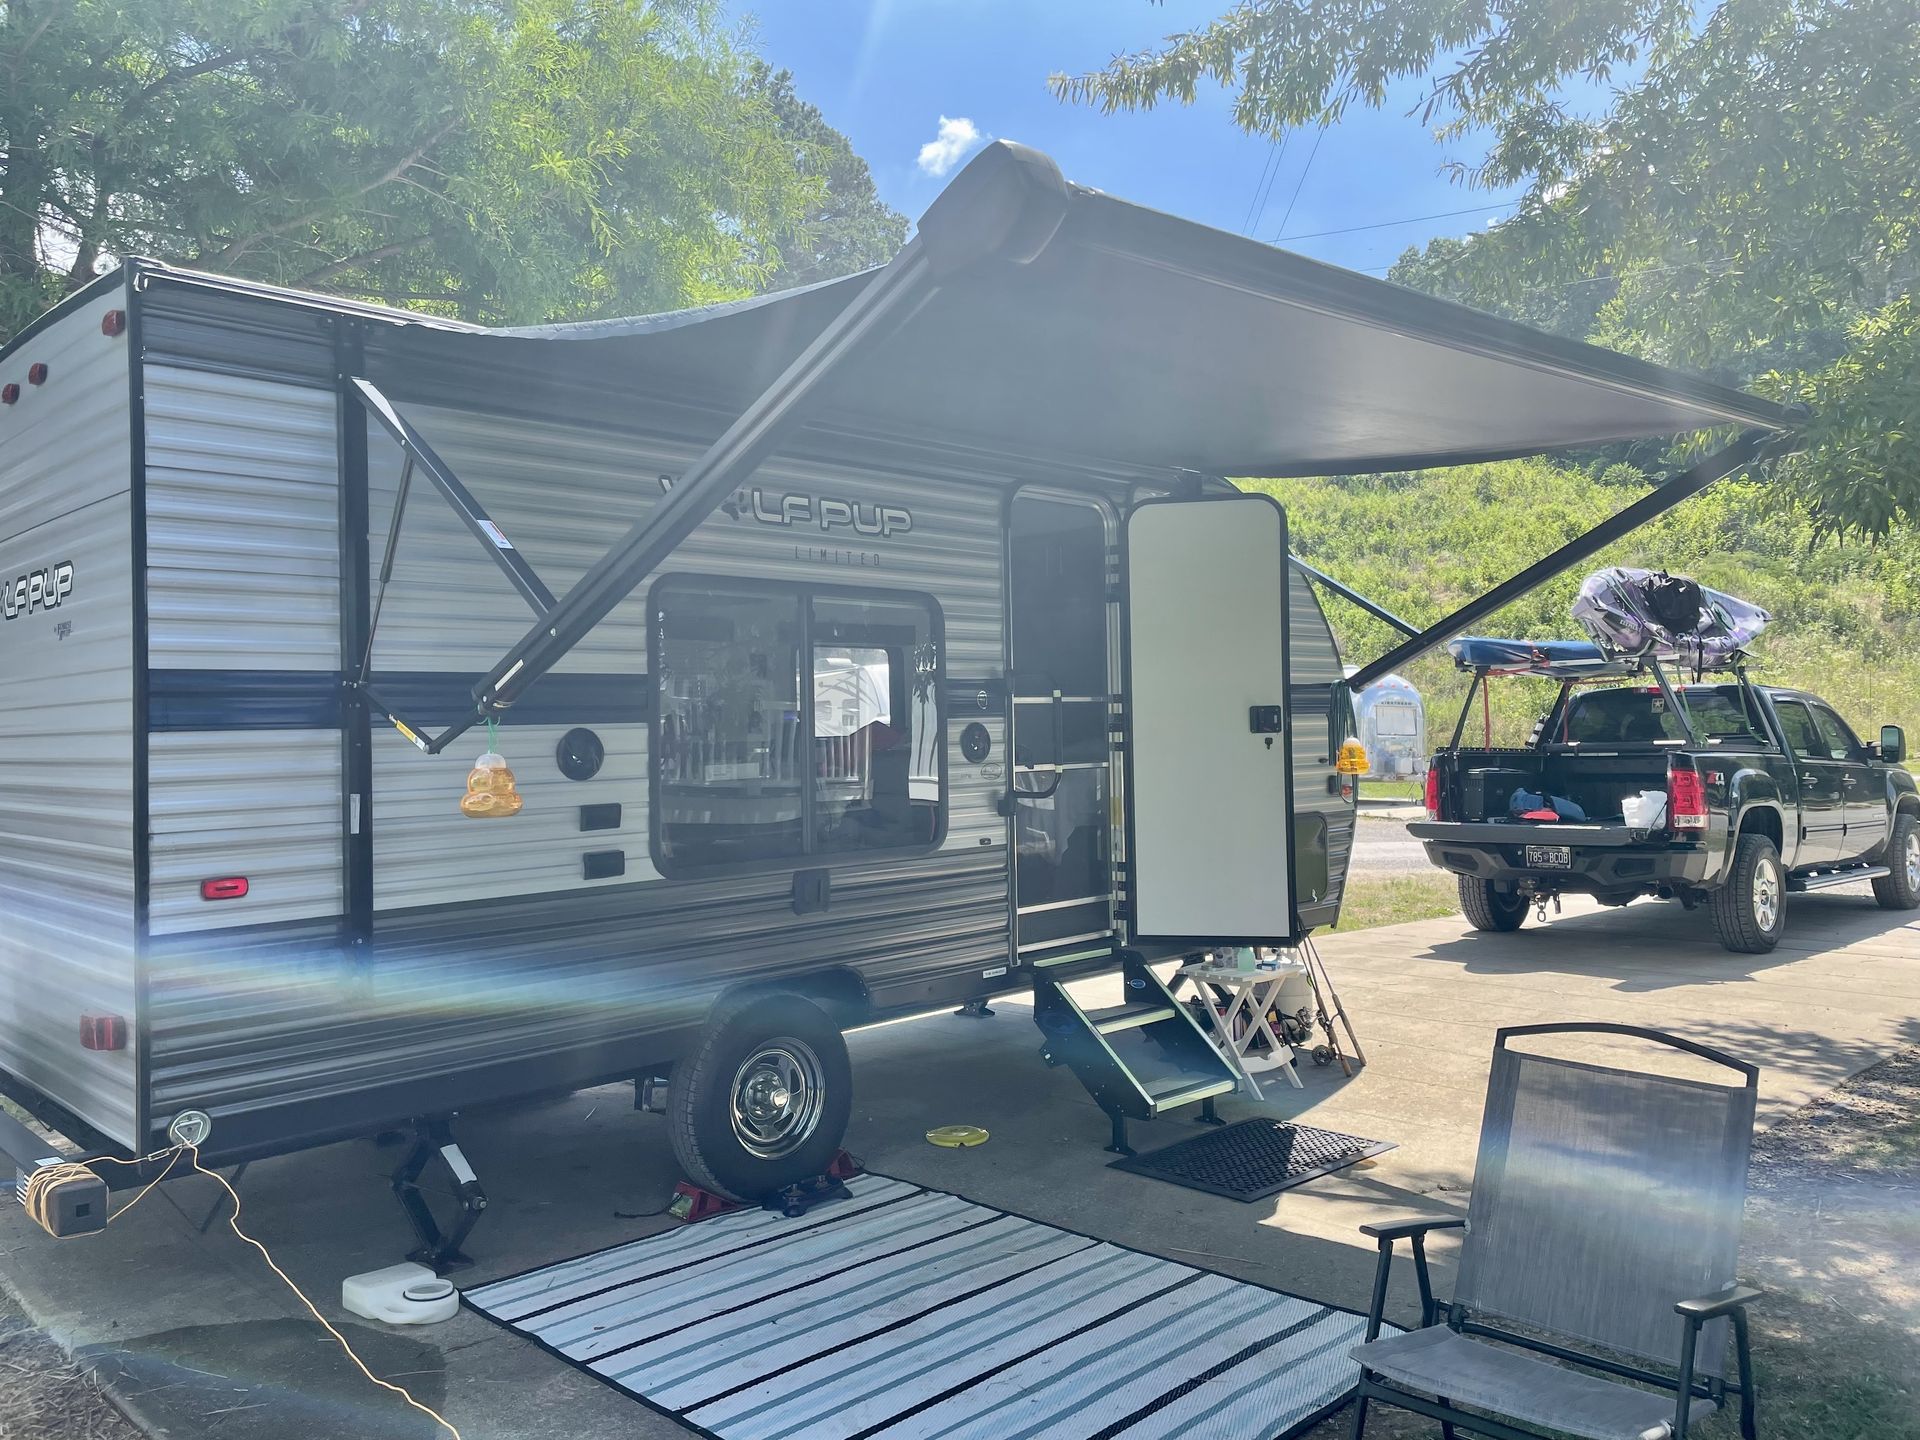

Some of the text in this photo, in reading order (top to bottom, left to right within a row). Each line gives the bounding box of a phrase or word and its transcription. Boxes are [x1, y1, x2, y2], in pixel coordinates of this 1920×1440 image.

[820, 498, 912, 537] PUP
[795, 545, 880, 567] LIMITED
[28, 560, 74, 615] PUP
[1528, 851, 1543, 863] 785
